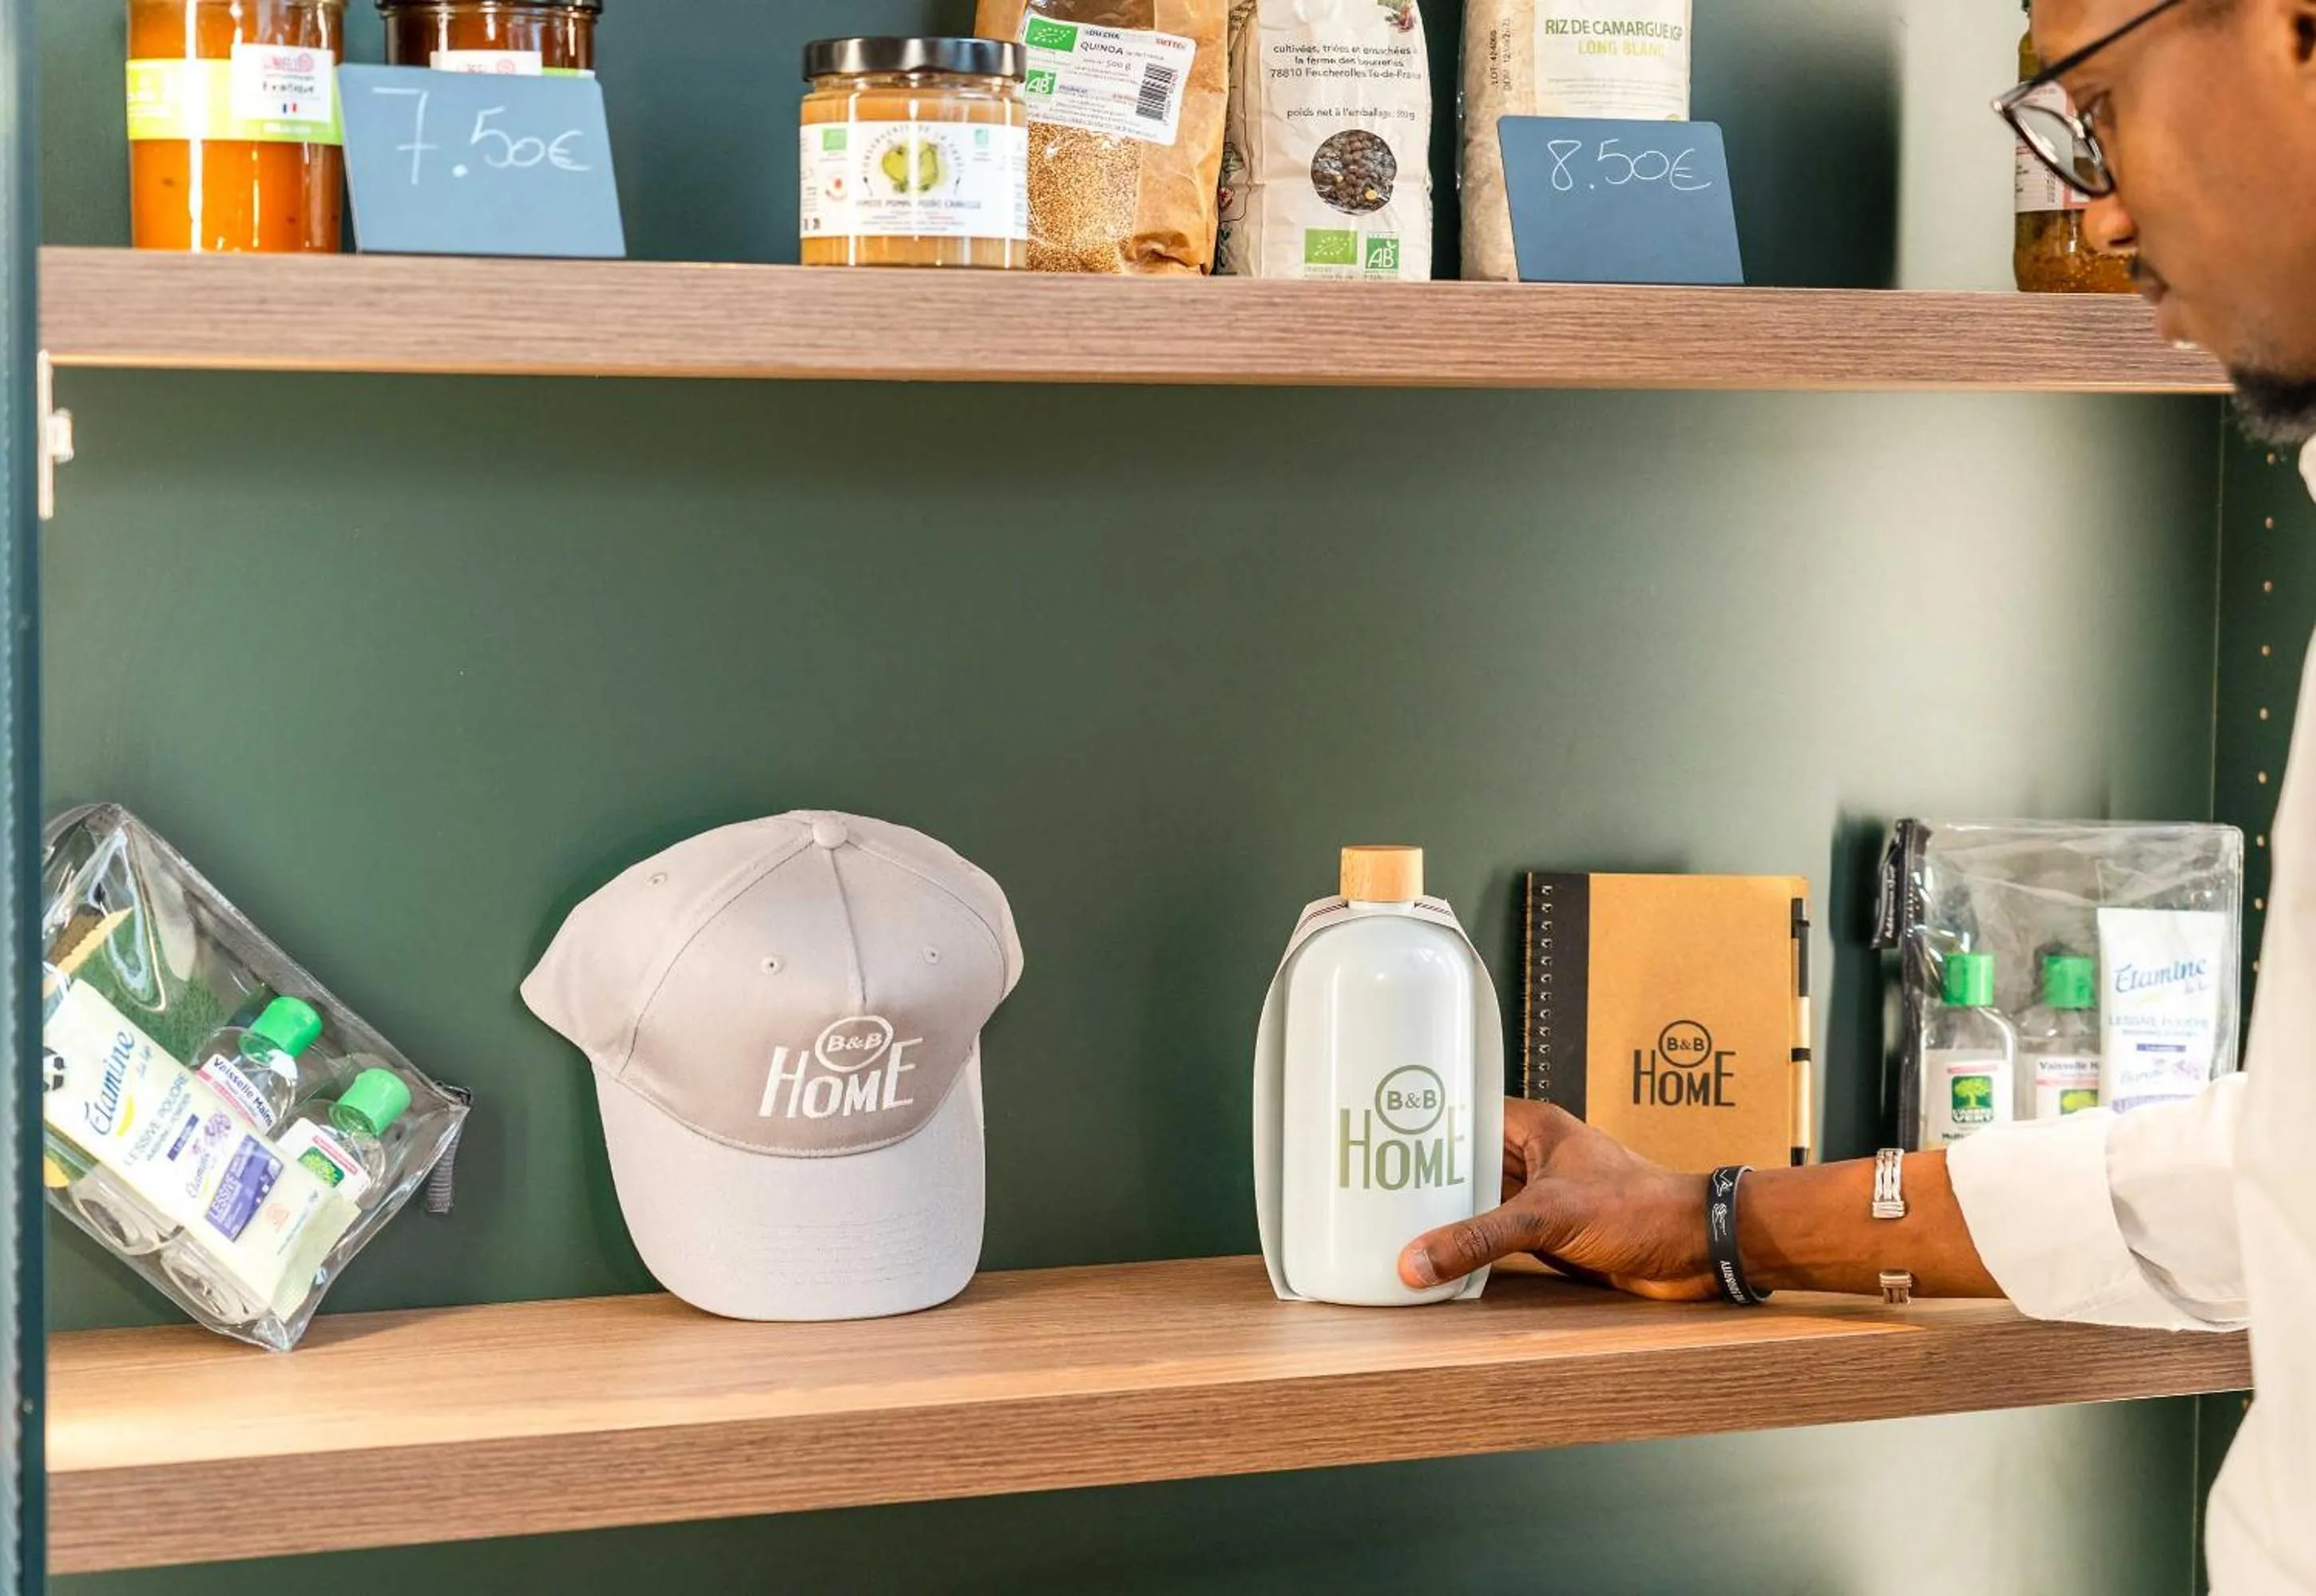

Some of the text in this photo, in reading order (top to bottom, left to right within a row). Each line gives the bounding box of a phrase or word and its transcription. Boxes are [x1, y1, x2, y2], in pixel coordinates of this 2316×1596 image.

[1545, 19, 1569, 34] RIZ
[1571, 20, 1591, 35] DE
[1592, 21, 1670, 39] CAMARGUE
[1080, 42, 1124, 56] QUINOA
[1578, 42, 1666, 58] LONG BLANC
[1295, 56, 1304, 65] la
[1307, 57, 1336, 65] ferme
[1287, 107, 1314, 119] poids
[1316, 108, 1333, 117] net
[371, 86, 593, 185] 7.50€
[1547, 139, 1713, 191] 8.50€
[1367, 246, 1394, 268] AB
[826, 1033, 882, 1052] B&B
[1667, 1037, 1705, 1051] B&B
[759, 1037, 924, 1119] HOME
[1632, 1049, 1737, 1107] HOME
[1387, 1089, 1438, 1111] B&B
[1339, 1105, 1467, 1190] HOME
